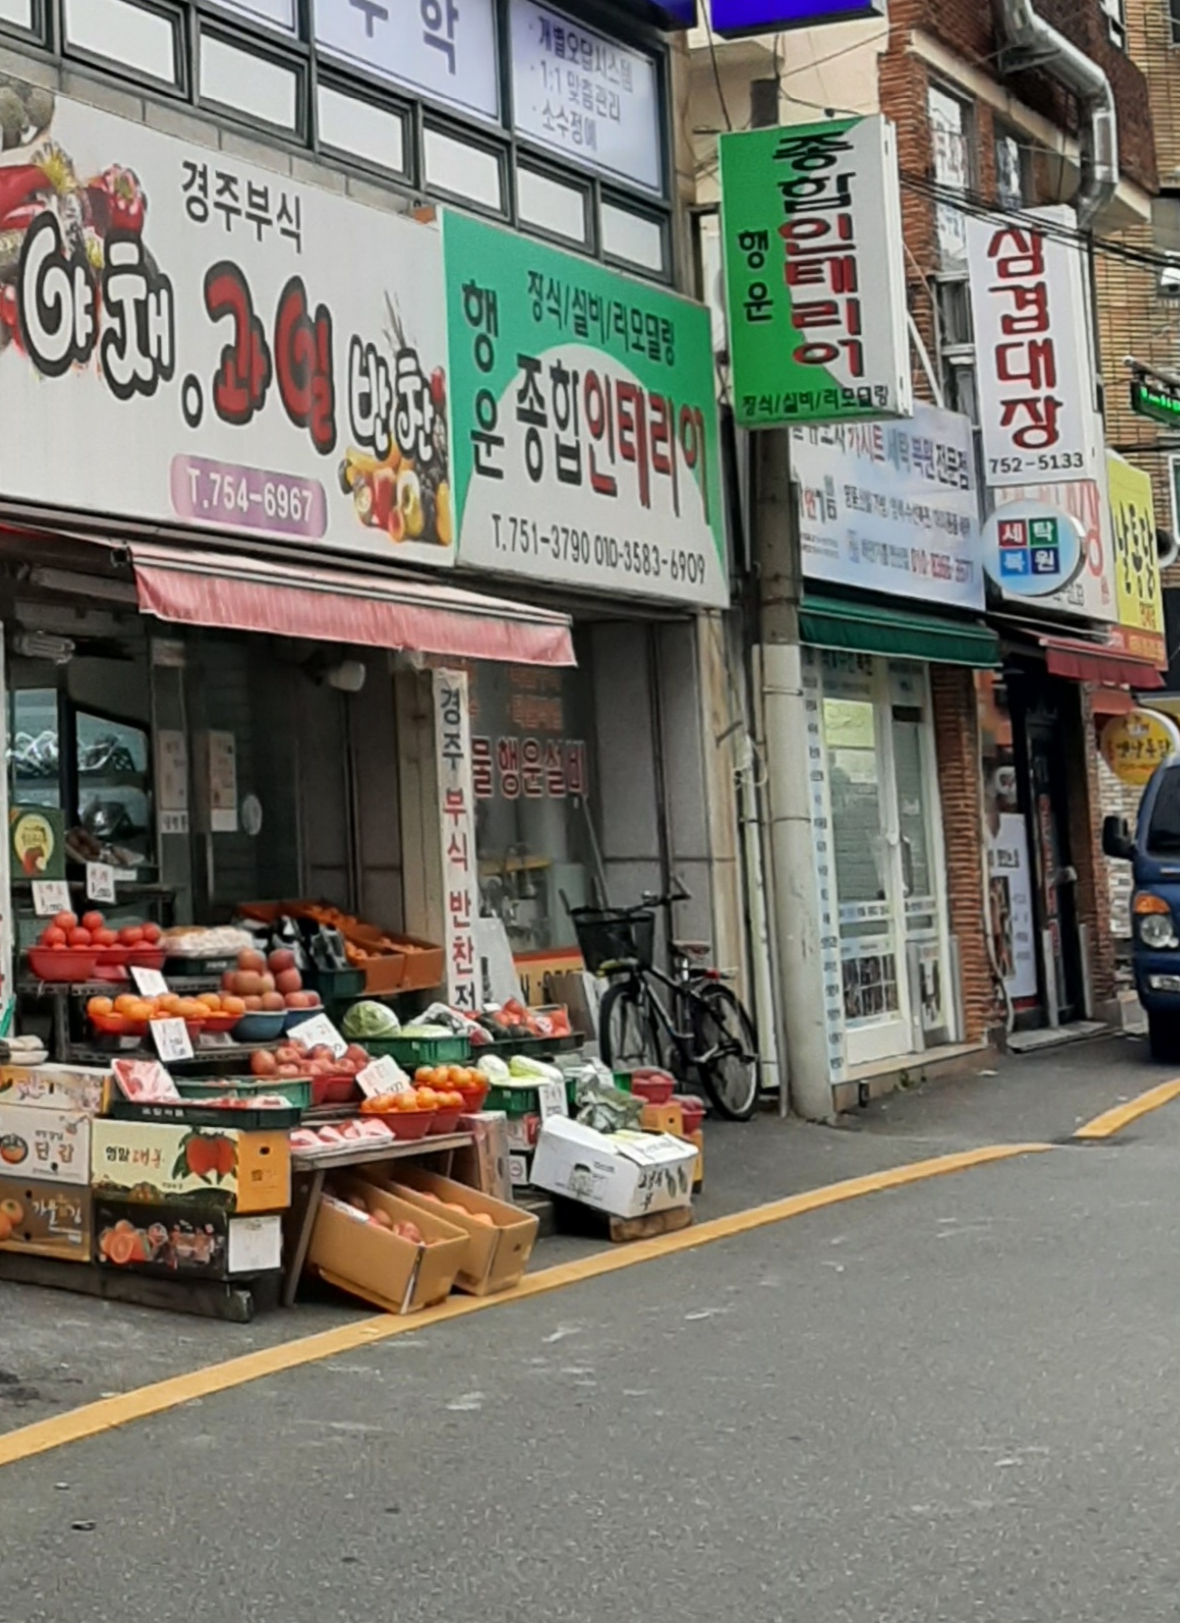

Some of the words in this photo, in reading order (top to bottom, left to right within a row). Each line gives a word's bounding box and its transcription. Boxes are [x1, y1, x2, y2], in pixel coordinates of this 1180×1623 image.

[181, 158, 303, 254] 경주부식
[737, 228, 774, 324] 행운
[461, 279, 506, 480] 행운
[186, 466, 315, 522] T.754-6967
[990, 452, 1085, 475] 752-5133
[441, 787, 468, 873] 부식
[449, 889, 476, 977] 반찬
